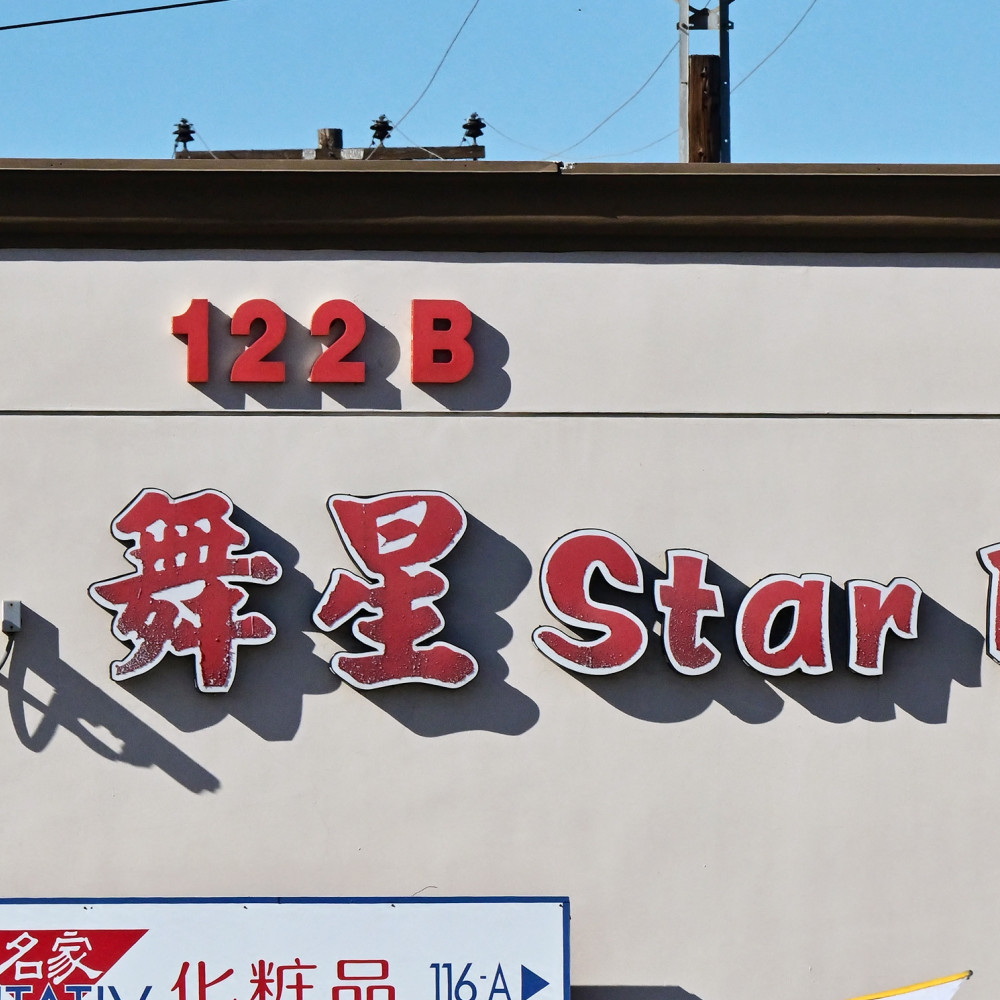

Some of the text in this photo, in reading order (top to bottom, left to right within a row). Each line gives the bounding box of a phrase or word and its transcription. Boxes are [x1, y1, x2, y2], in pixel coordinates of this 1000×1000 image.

[171, 298, 475, 384] 122 B
[88, 487, 480, 693] 舞星
[532, 528, 923, 677] Star
[0, 931, 104, 985] 名家
